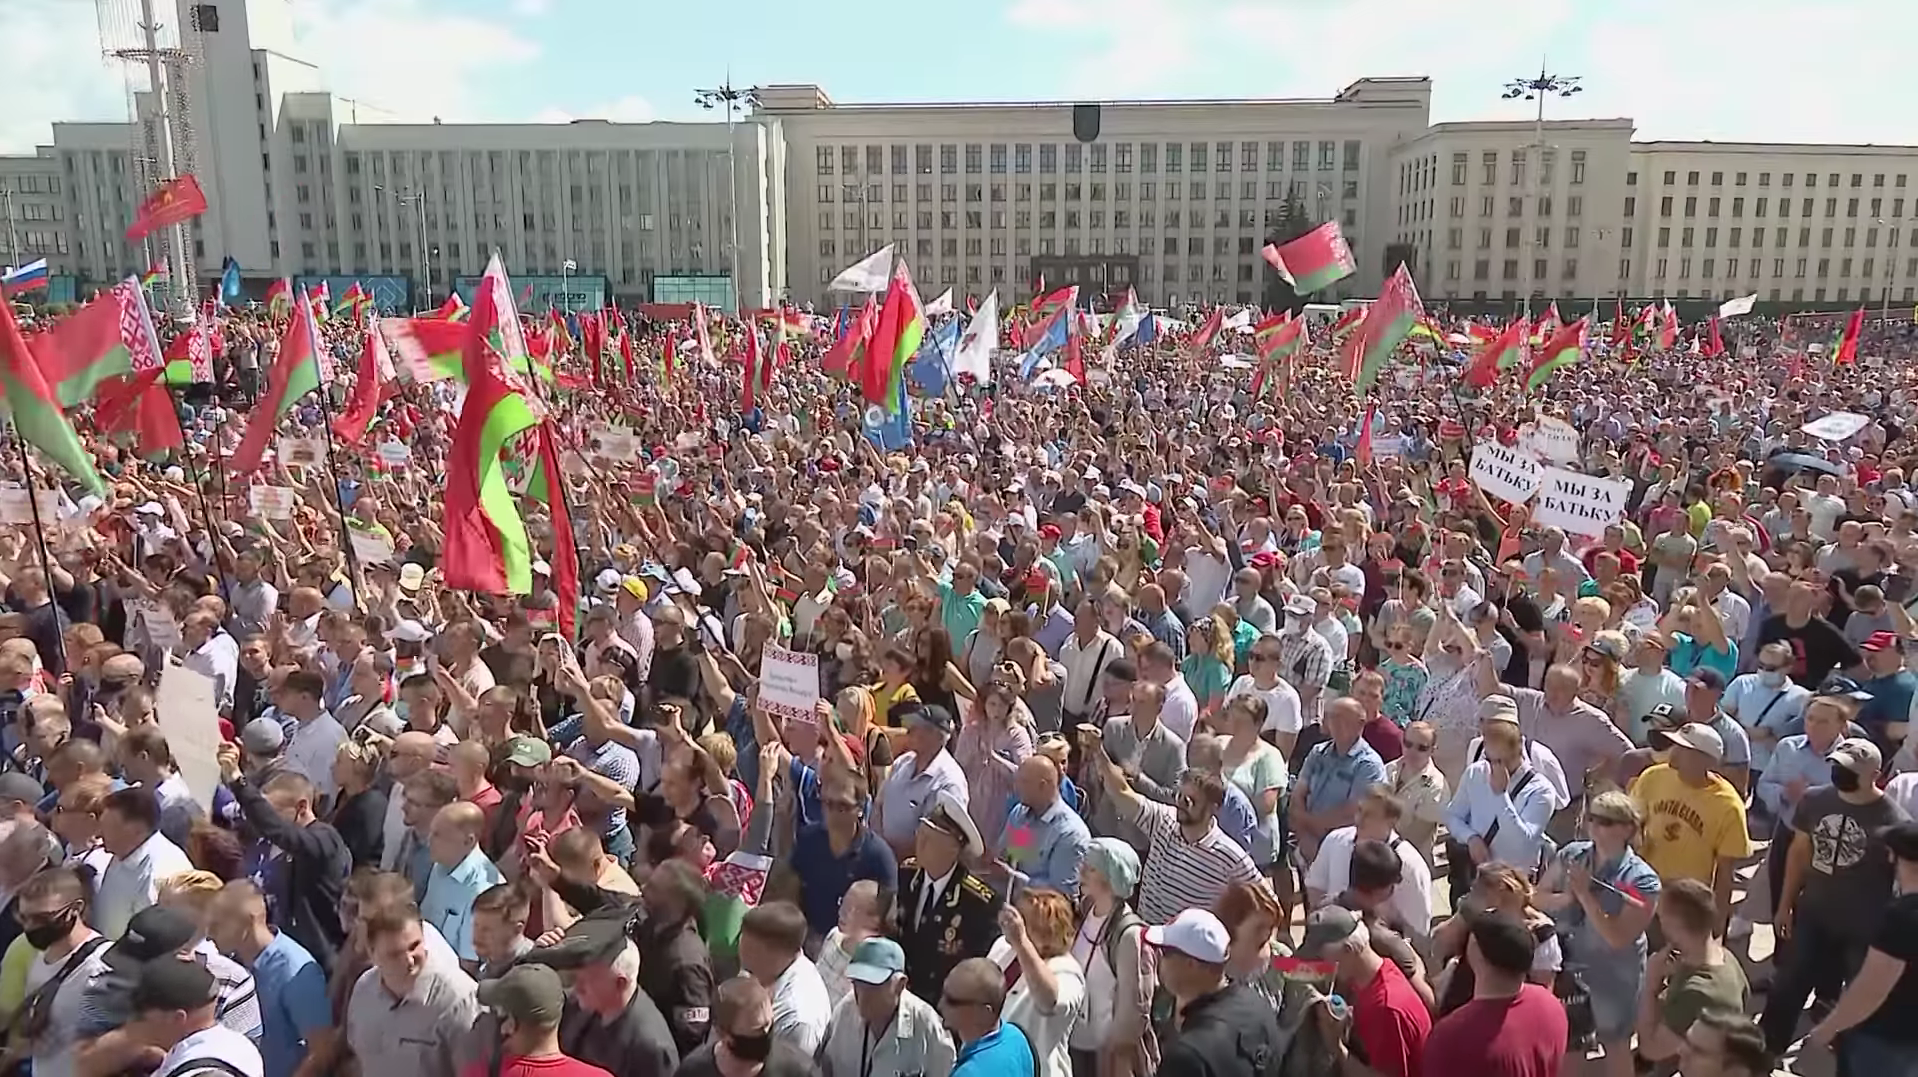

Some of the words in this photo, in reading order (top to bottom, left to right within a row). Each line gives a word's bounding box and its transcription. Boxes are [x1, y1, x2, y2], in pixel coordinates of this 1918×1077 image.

[1487, 446, 1515, 464] МЫ
[1520, 457, 1535, 474] ЗА
[1475, 458, 1536, 491] БАТЬКУ
[1554, 480, 1586, 497] МЫ
[1591, 487, 1611, 503] ЗА
[1545, 497, 1616, 521] БАТЬКУ
